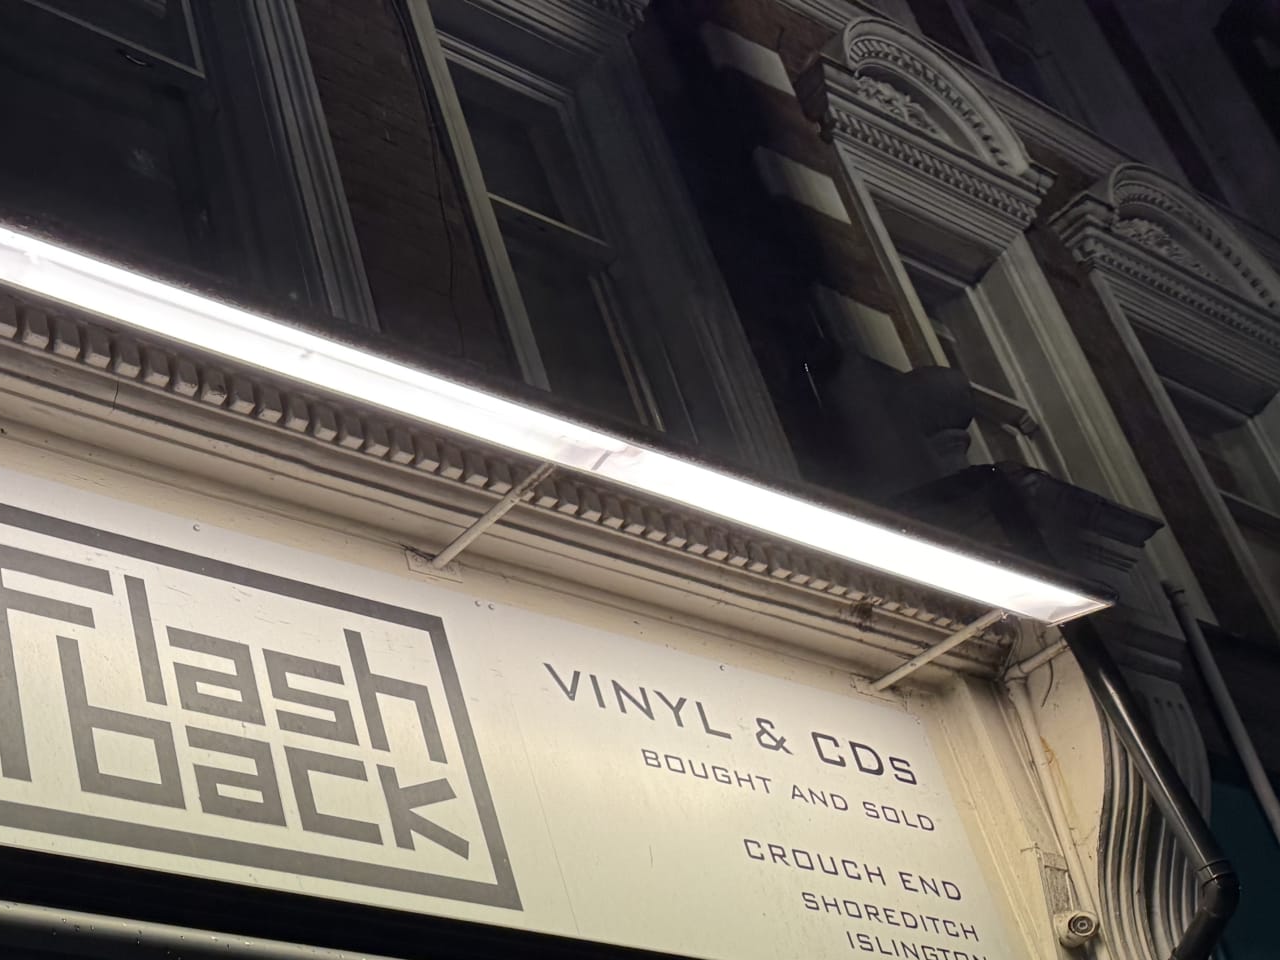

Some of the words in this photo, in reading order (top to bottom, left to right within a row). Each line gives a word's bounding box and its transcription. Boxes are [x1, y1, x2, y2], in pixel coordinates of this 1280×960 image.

[56, 635, 470, 861] back
[543, 662, 733, 740] VINYL
[756, 717, 794, 755] &
[641, 748, 773, 794] BOUGHT
[790, 784, 849, 812] AND
[862, 800, 935, 832] SOLD
[743, 838, 887, 886] CROUCH
[898, 871, 962, 901] END
[801, 891, 980, 942] SHOREDITCH
